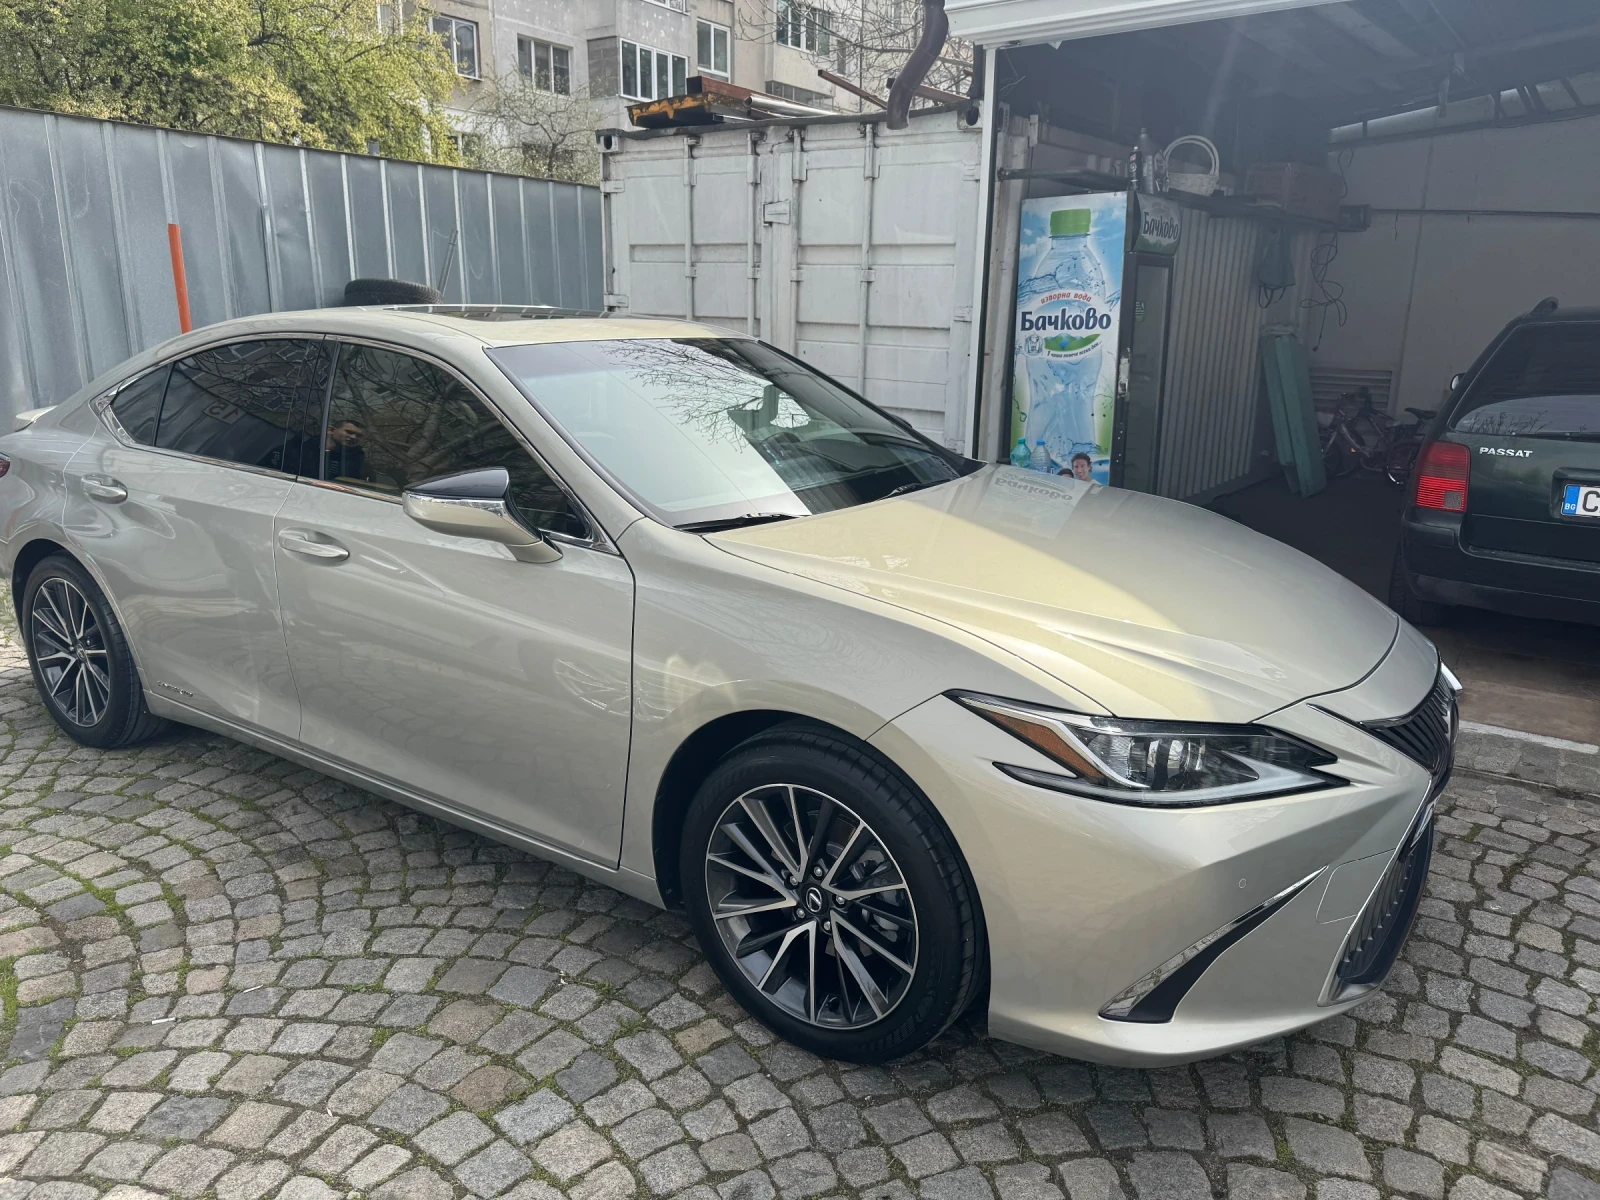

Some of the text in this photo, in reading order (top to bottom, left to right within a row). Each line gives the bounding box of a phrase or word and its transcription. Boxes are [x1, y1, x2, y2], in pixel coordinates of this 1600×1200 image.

[1142, 211, 1179, 240] Бачково
[1041, 292, 1092, 304] изворна вода
[1020, 307, 1112, 331] Бачково
[1479, 446, 1533, 458] PASSAT
[1564, 502, 1577, 511] BG
[1582, 490, 1600, 513] C
